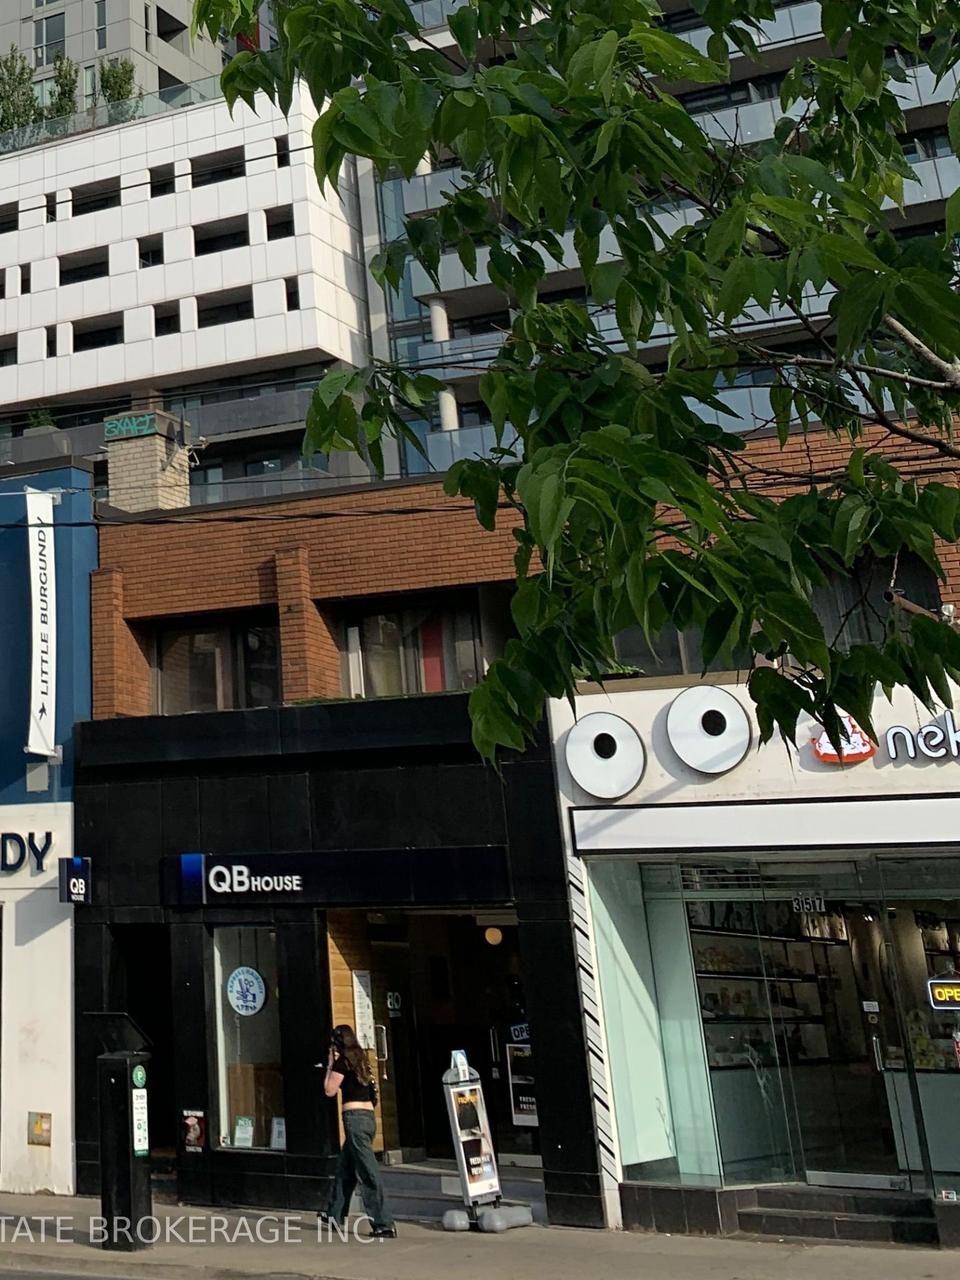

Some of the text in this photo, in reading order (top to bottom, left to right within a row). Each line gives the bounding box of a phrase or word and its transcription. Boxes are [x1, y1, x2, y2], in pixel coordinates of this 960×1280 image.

[37, 516, 49, 696] LITTLE BURGUNDY
[70, 878, 86, 894] QB
[209, 865, 303, 893] QB HOUSE
[793, 897, 825, 912] 357
